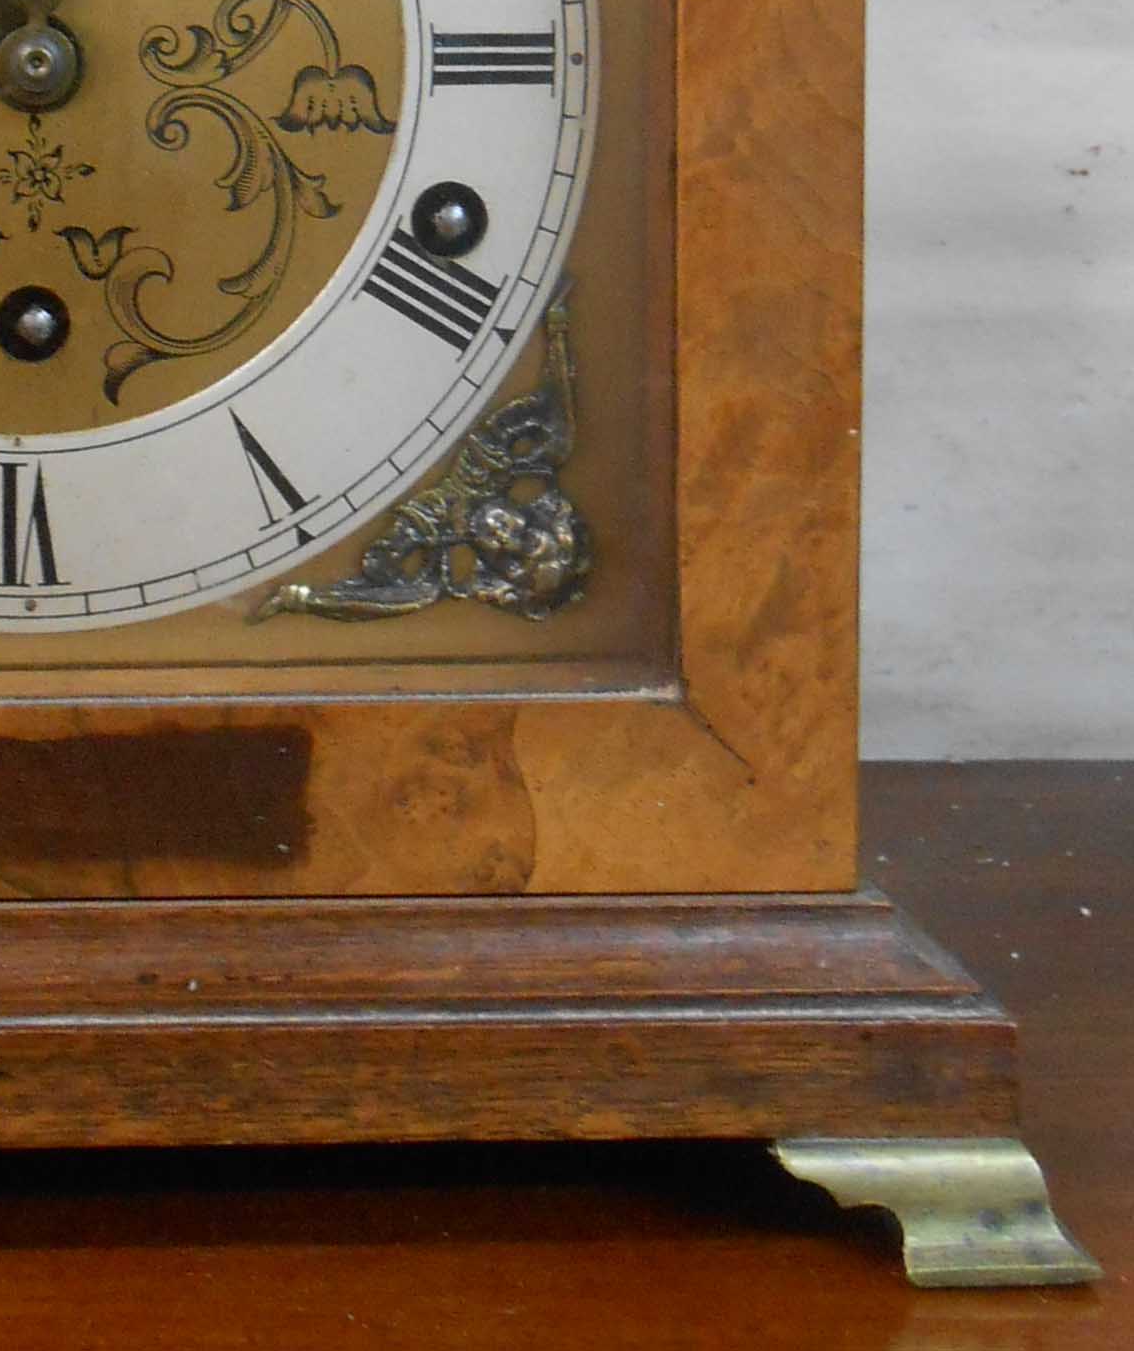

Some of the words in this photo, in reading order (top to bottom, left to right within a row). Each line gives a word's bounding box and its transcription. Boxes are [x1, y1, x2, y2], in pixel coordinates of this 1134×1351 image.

[429, 20, 556, 98] III
[352, 215, 509, 363] IIII
[228, 407, 321, 531] V
